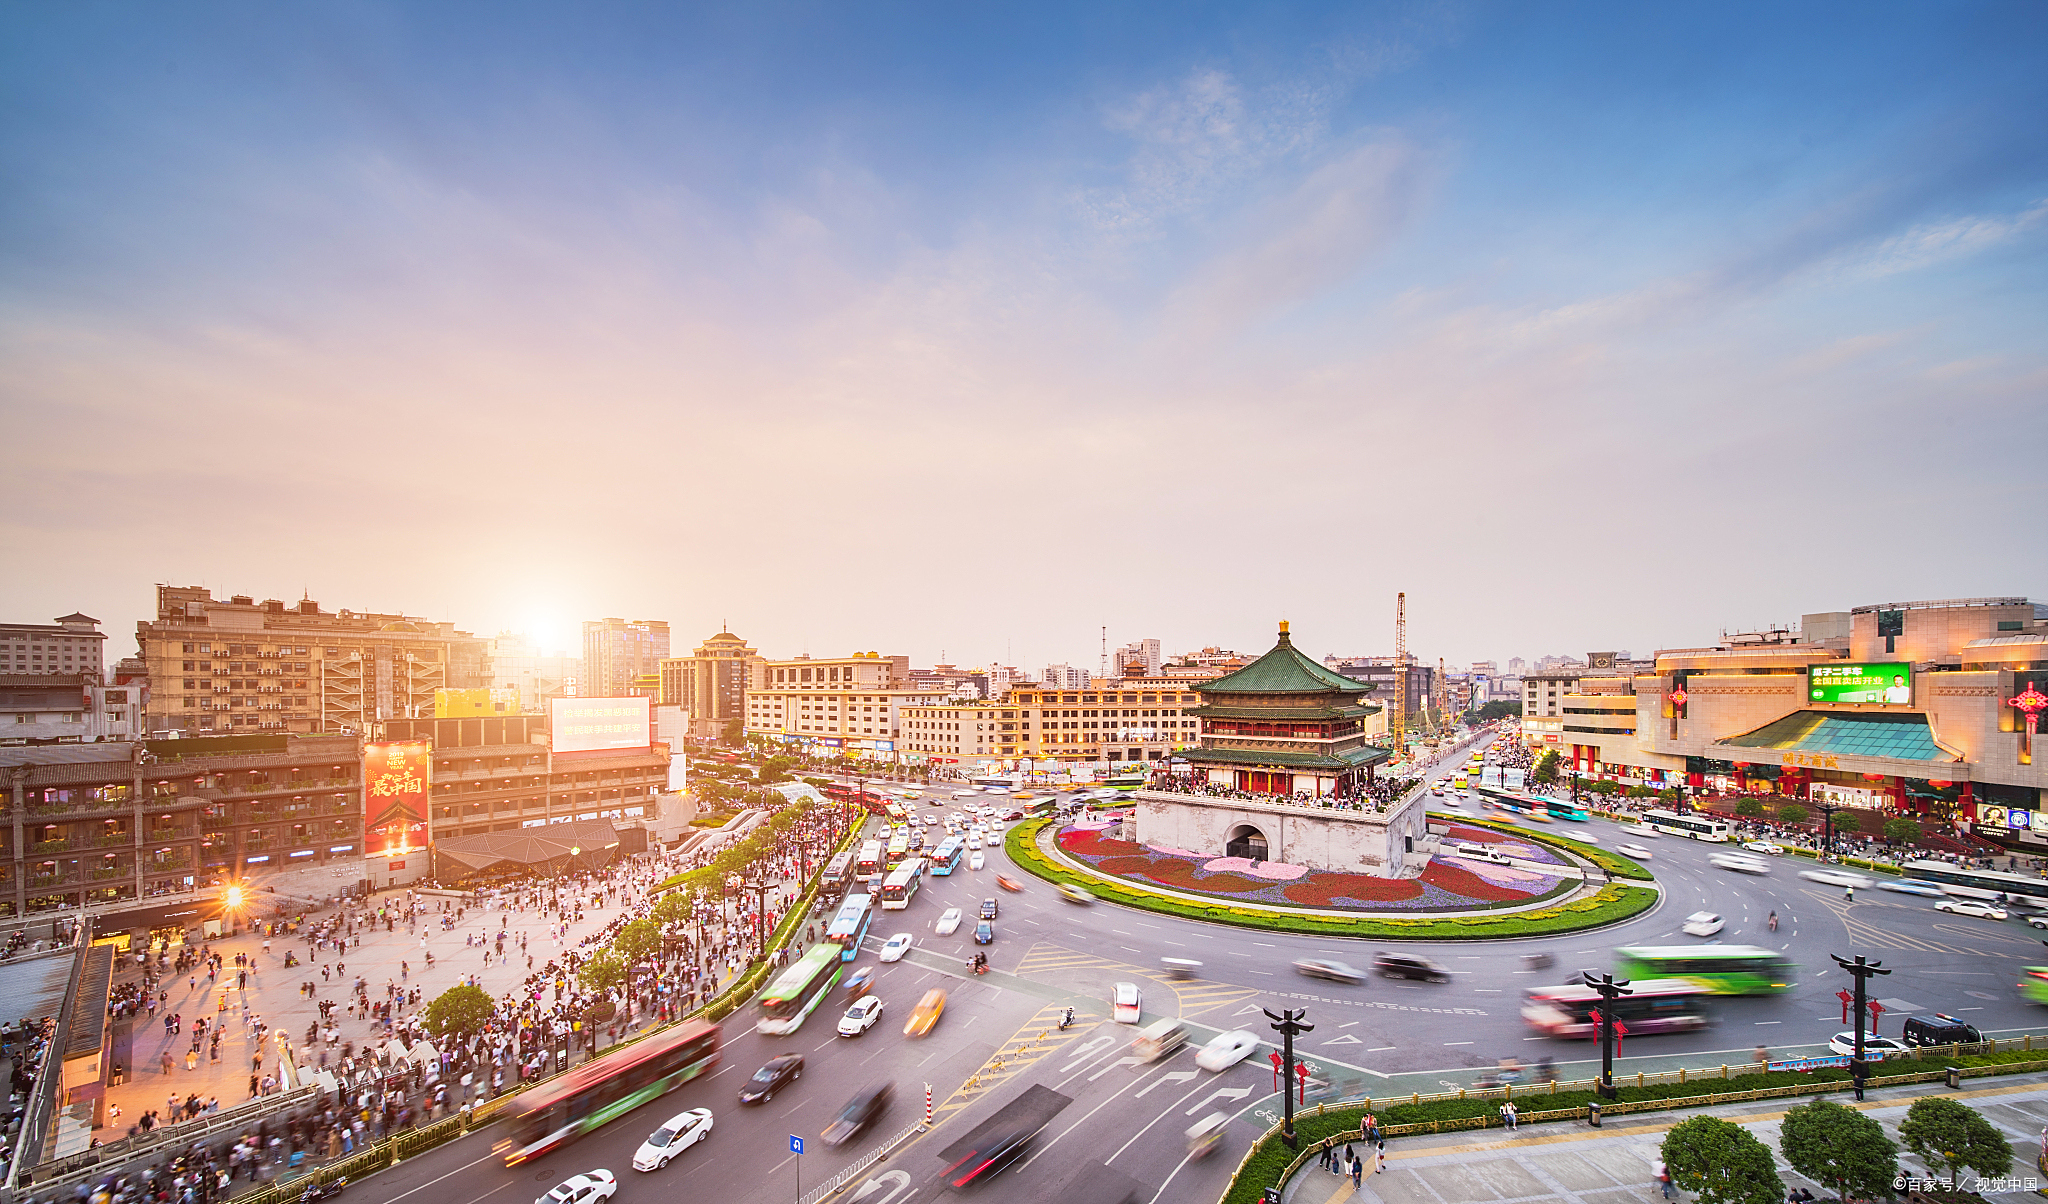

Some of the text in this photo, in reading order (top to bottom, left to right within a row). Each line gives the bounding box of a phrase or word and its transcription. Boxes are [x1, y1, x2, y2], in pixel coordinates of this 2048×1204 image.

[1812, 667, 1863, 677] 瓜子二手车
[1812, 677, 1884, 686] 全国直卖店开业
[563, 707, 641, 718] 检举揭发黑恶犯罪
[563, 723, 641, 735] 警民联手共建平安
[386, 759, 407, 767] NEW
[368, 777, 423, 798] 最中国
